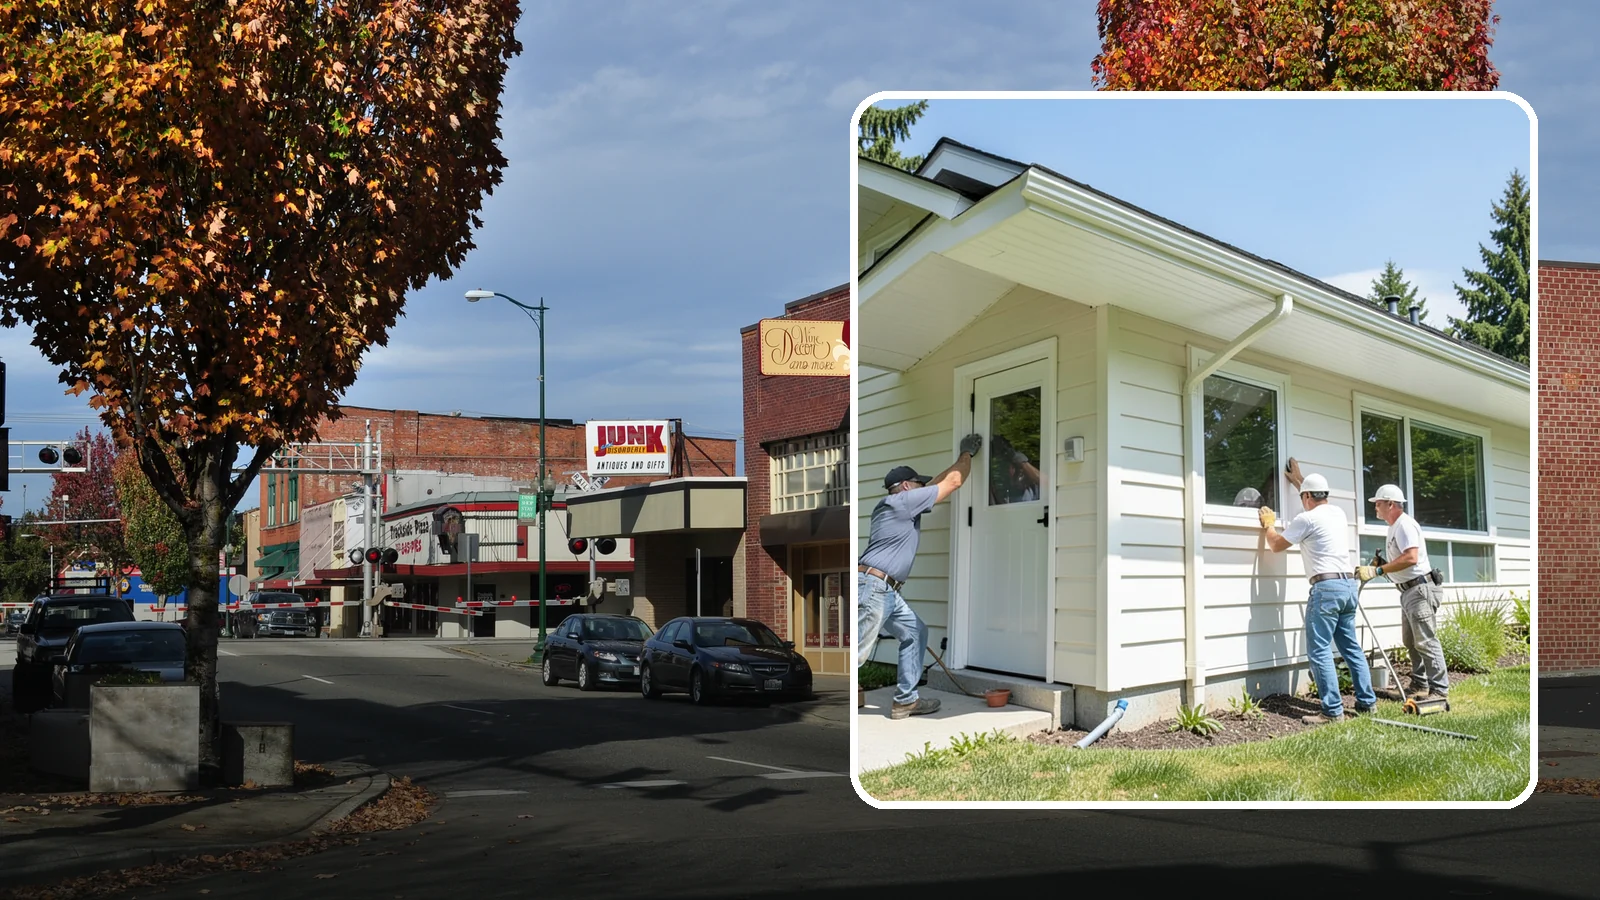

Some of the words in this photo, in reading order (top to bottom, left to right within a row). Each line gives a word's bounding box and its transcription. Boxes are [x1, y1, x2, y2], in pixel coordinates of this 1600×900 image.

[595, 425, 665, 457] JUNK
[607, 445, 646, 454] DISORDERLY
[596, 461, 628, 470] ANTIQUES
[631, 461, 644, 470] AND
[646, 460, 665, 469] GIFTS
[352, 498, 365, 511] CRO
[390, 521, 413, 539] Trackside
[414, 519, 429, 535] Pizza
